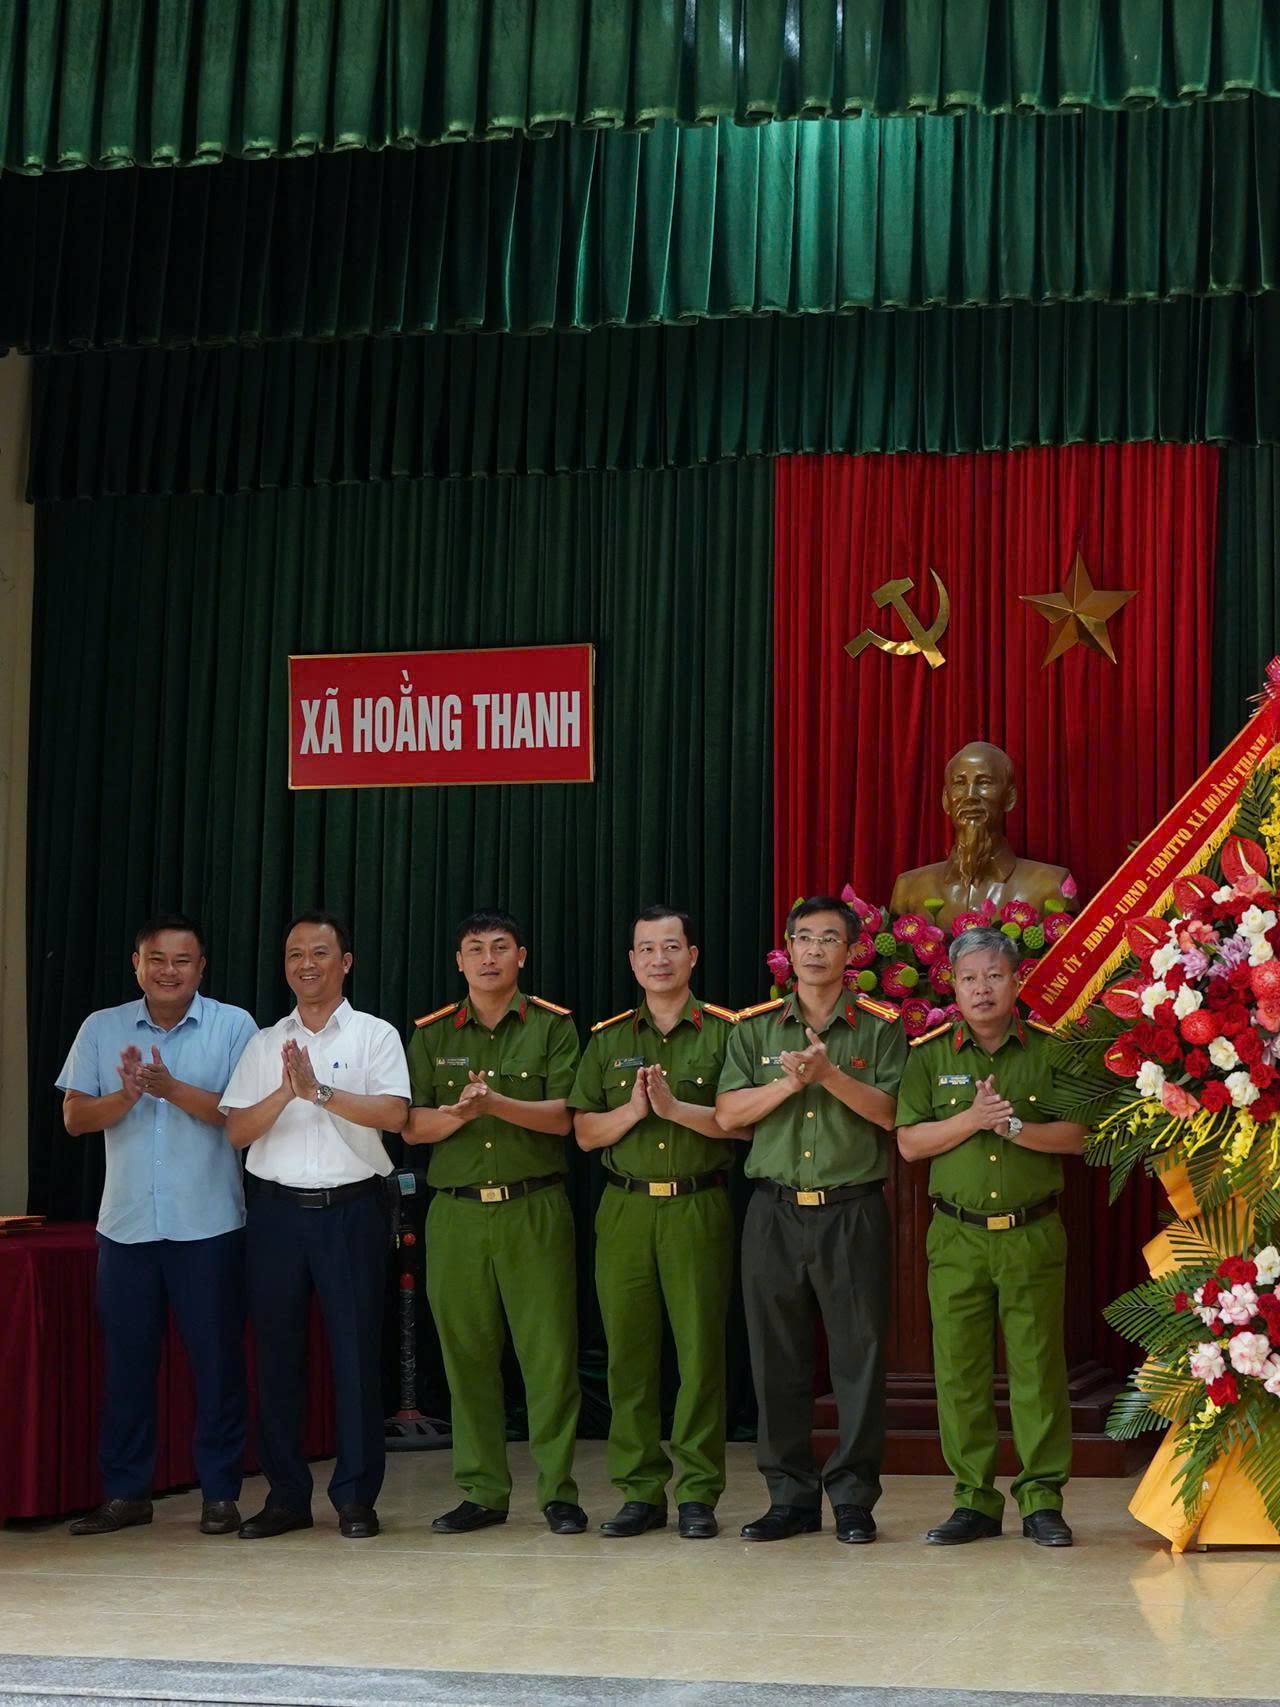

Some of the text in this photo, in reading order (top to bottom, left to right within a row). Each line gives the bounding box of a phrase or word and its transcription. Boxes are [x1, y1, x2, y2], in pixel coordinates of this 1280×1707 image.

[299, 669, 581, 755] XÃ HOẰNG THANH
[1115, 879, 1149, 915] UBND
[1185, 810, 1209, 834] XÃ
